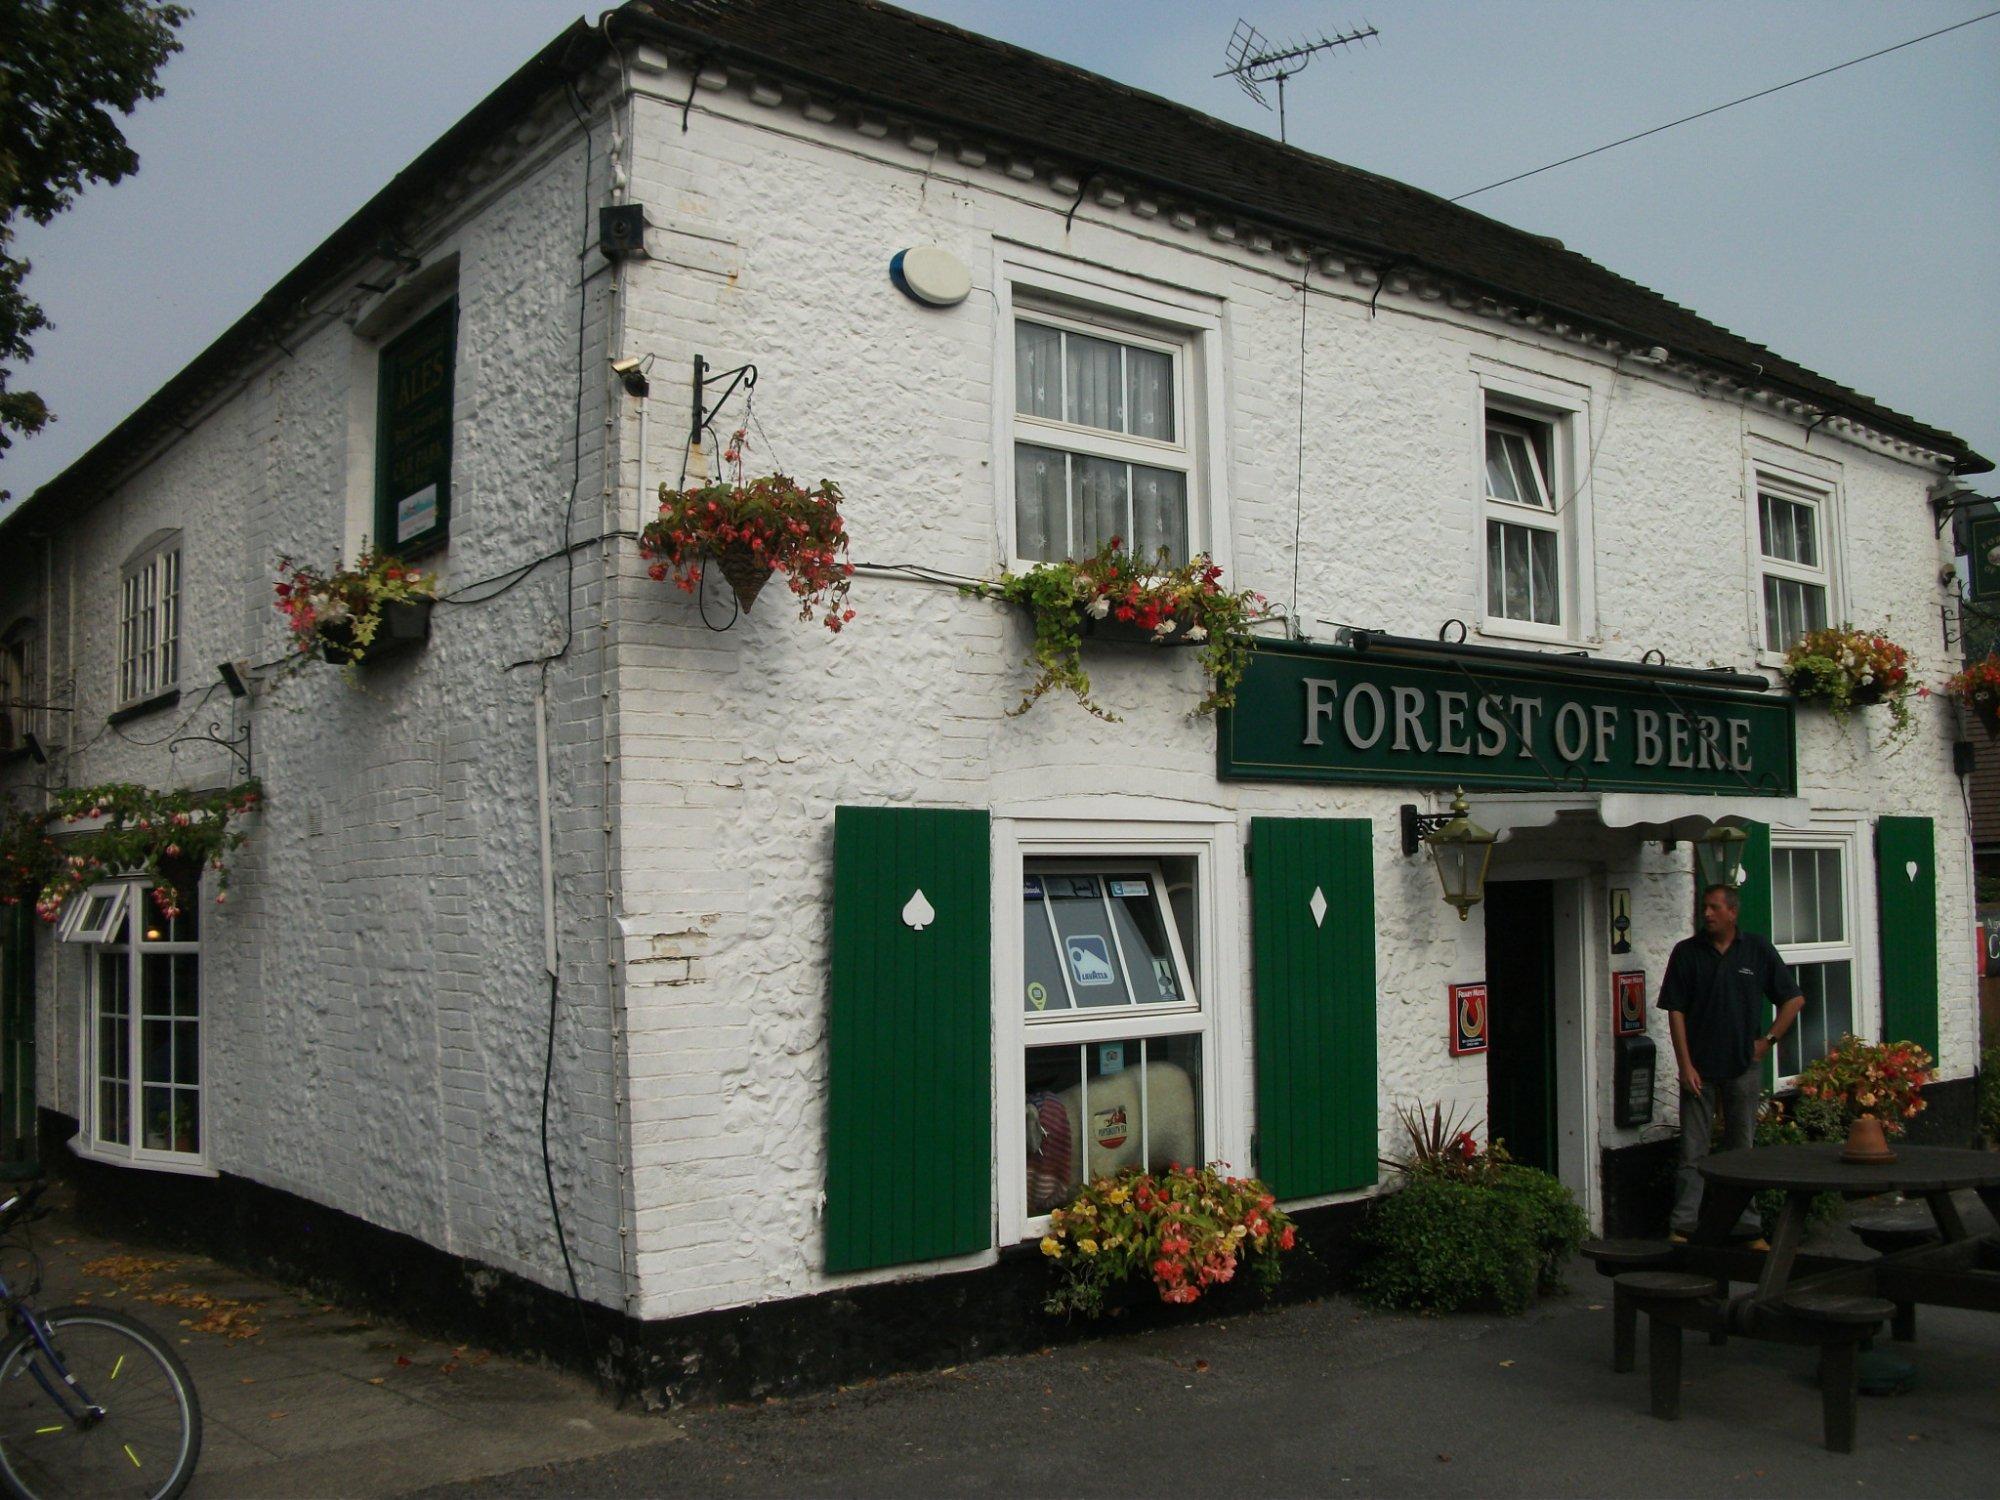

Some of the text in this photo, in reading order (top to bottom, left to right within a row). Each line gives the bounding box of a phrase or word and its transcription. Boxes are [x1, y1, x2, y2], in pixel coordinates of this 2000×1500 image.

[397, 348, 443, 411] ALES
[1302, 677, 1753, 772] FOREST OF BERE
